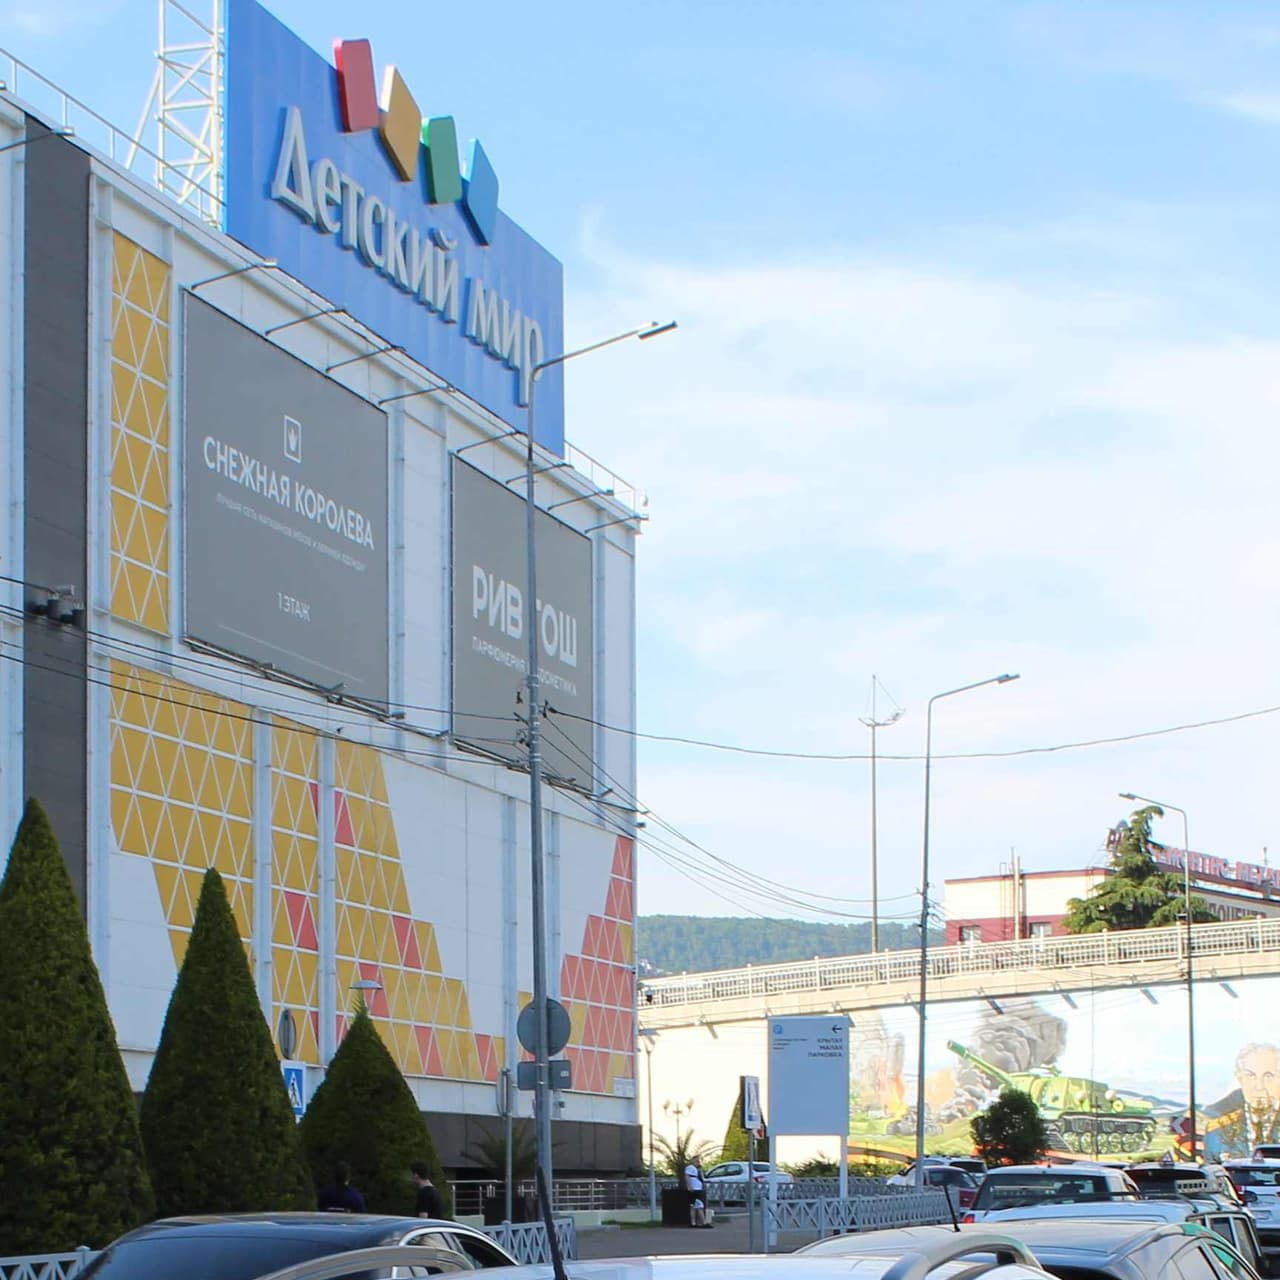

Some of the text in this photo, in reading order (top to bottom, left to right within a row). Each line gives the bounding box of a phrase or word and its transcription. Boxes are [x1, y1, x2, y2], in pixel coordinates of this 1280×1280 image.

[270, 105, 544, 408] Детский мир
[203, 436, 375, 550] СНЕЖНАЯ КОРОЛЕВА
[283, 595, 311, 621] ЭТАЖ
[472, 564, 577, 667] РИВ ОШ
